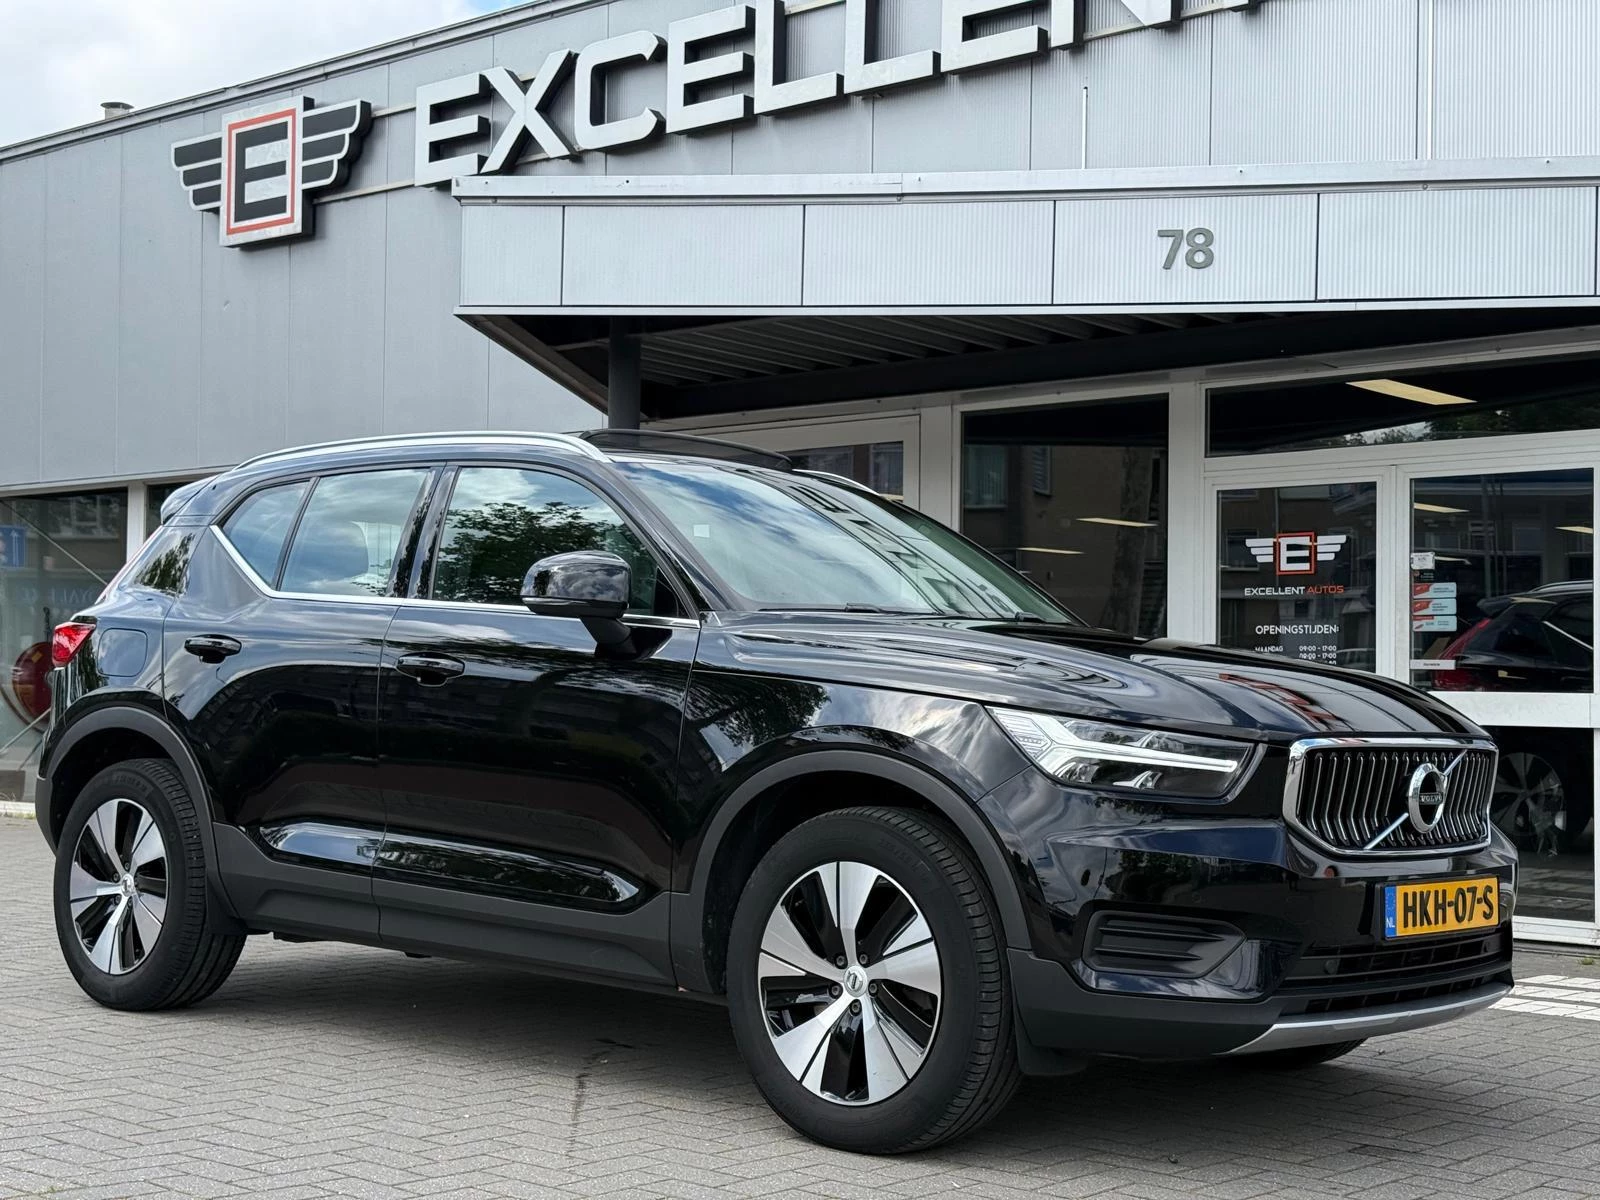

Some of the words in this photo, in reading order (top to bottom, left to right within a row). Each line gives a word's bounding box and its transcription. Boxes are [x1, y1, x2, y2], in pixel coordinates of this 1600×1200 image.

[414, 0, 1254, 187] EXCELLE
[234, 121, 289, 223] E
[1157, 227, 1215, 270] 78
[1280, 536, 1310, 571] E
[1244, 586, 1305, 596] EXCELLENT
[1306, 585, 1344, 595] AUTOS
[1386, 916, 1396, 928] NL
[1403, 885, 1494, 929] HKH-07-S
